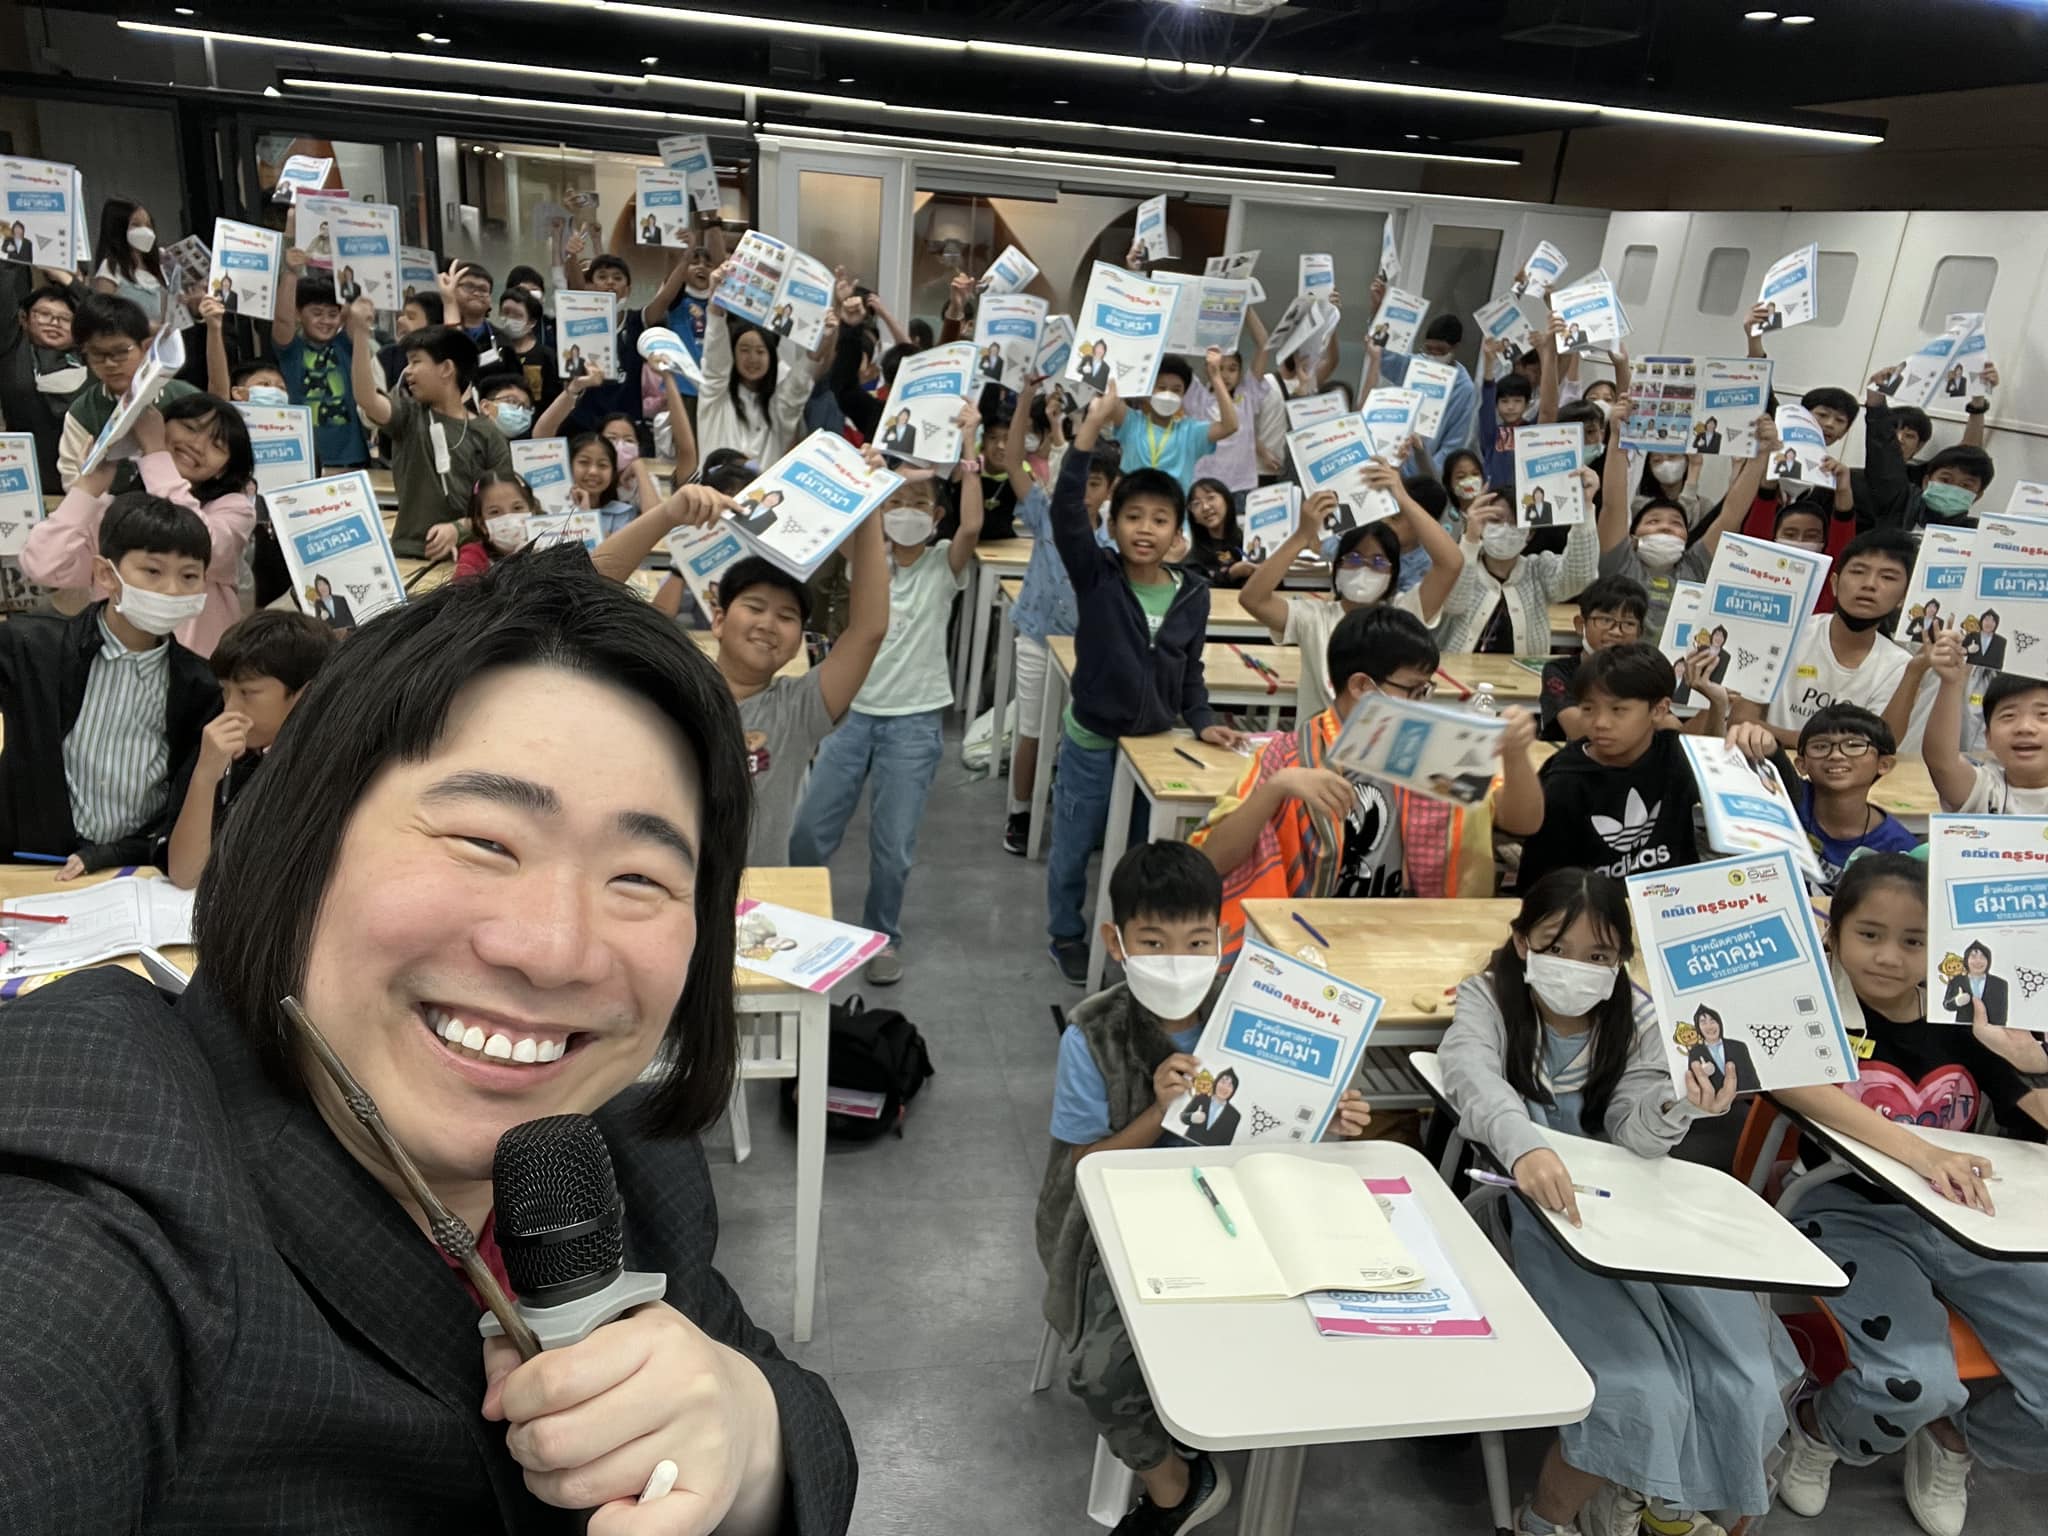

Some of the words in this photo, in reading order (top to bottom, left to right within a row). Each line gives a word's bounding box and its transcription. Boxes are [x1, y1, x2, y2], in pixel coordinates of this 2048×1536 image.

[1725, 596, 1781, 616] สมาคมฯ
[1961, 847, 2048, 864] คณิตครูSu
[1661, 892, 1768, 919] คณิตครูSup'k
[1686, 937, 1778, 977] สมาคมฯ
[1252, 979, 1341, 1027] คณิตครูSup'k
[1242, 1027, 1321, 1065] สมาคมฯ
